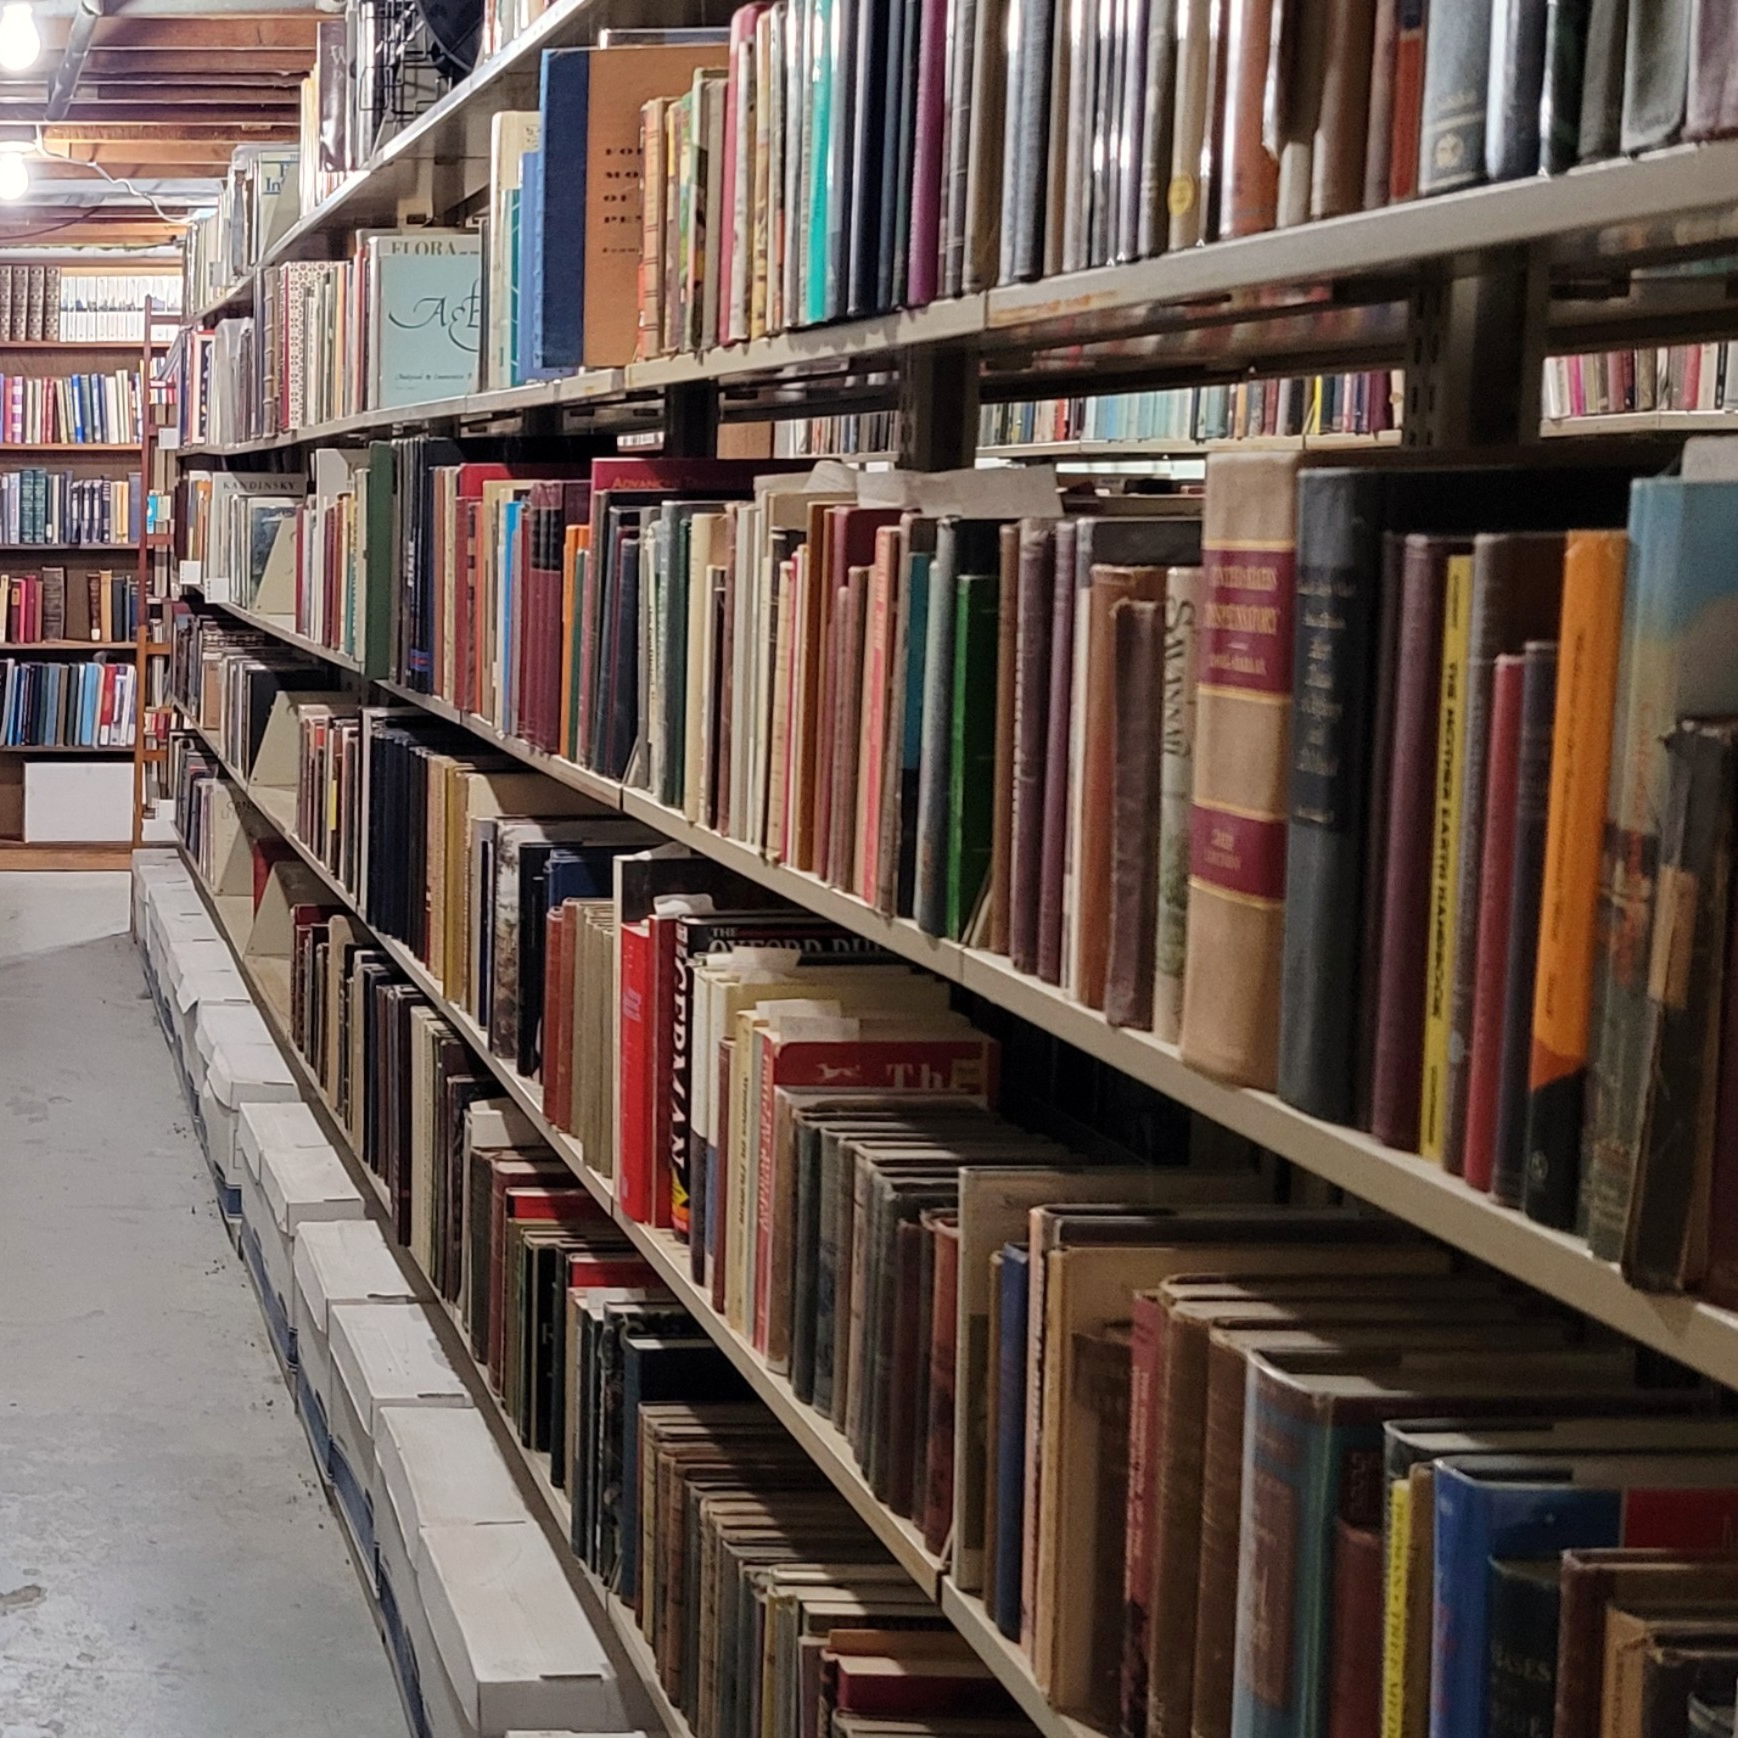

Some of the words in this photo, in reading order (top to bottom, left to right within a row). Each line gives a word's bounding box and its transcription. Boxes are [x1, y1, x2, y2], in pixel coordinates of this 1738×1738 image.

[391, 241, 456, 256] FLORA
[223, 481, 295, 491] KANDINSKY
[712, 927, 739, 938] THE
